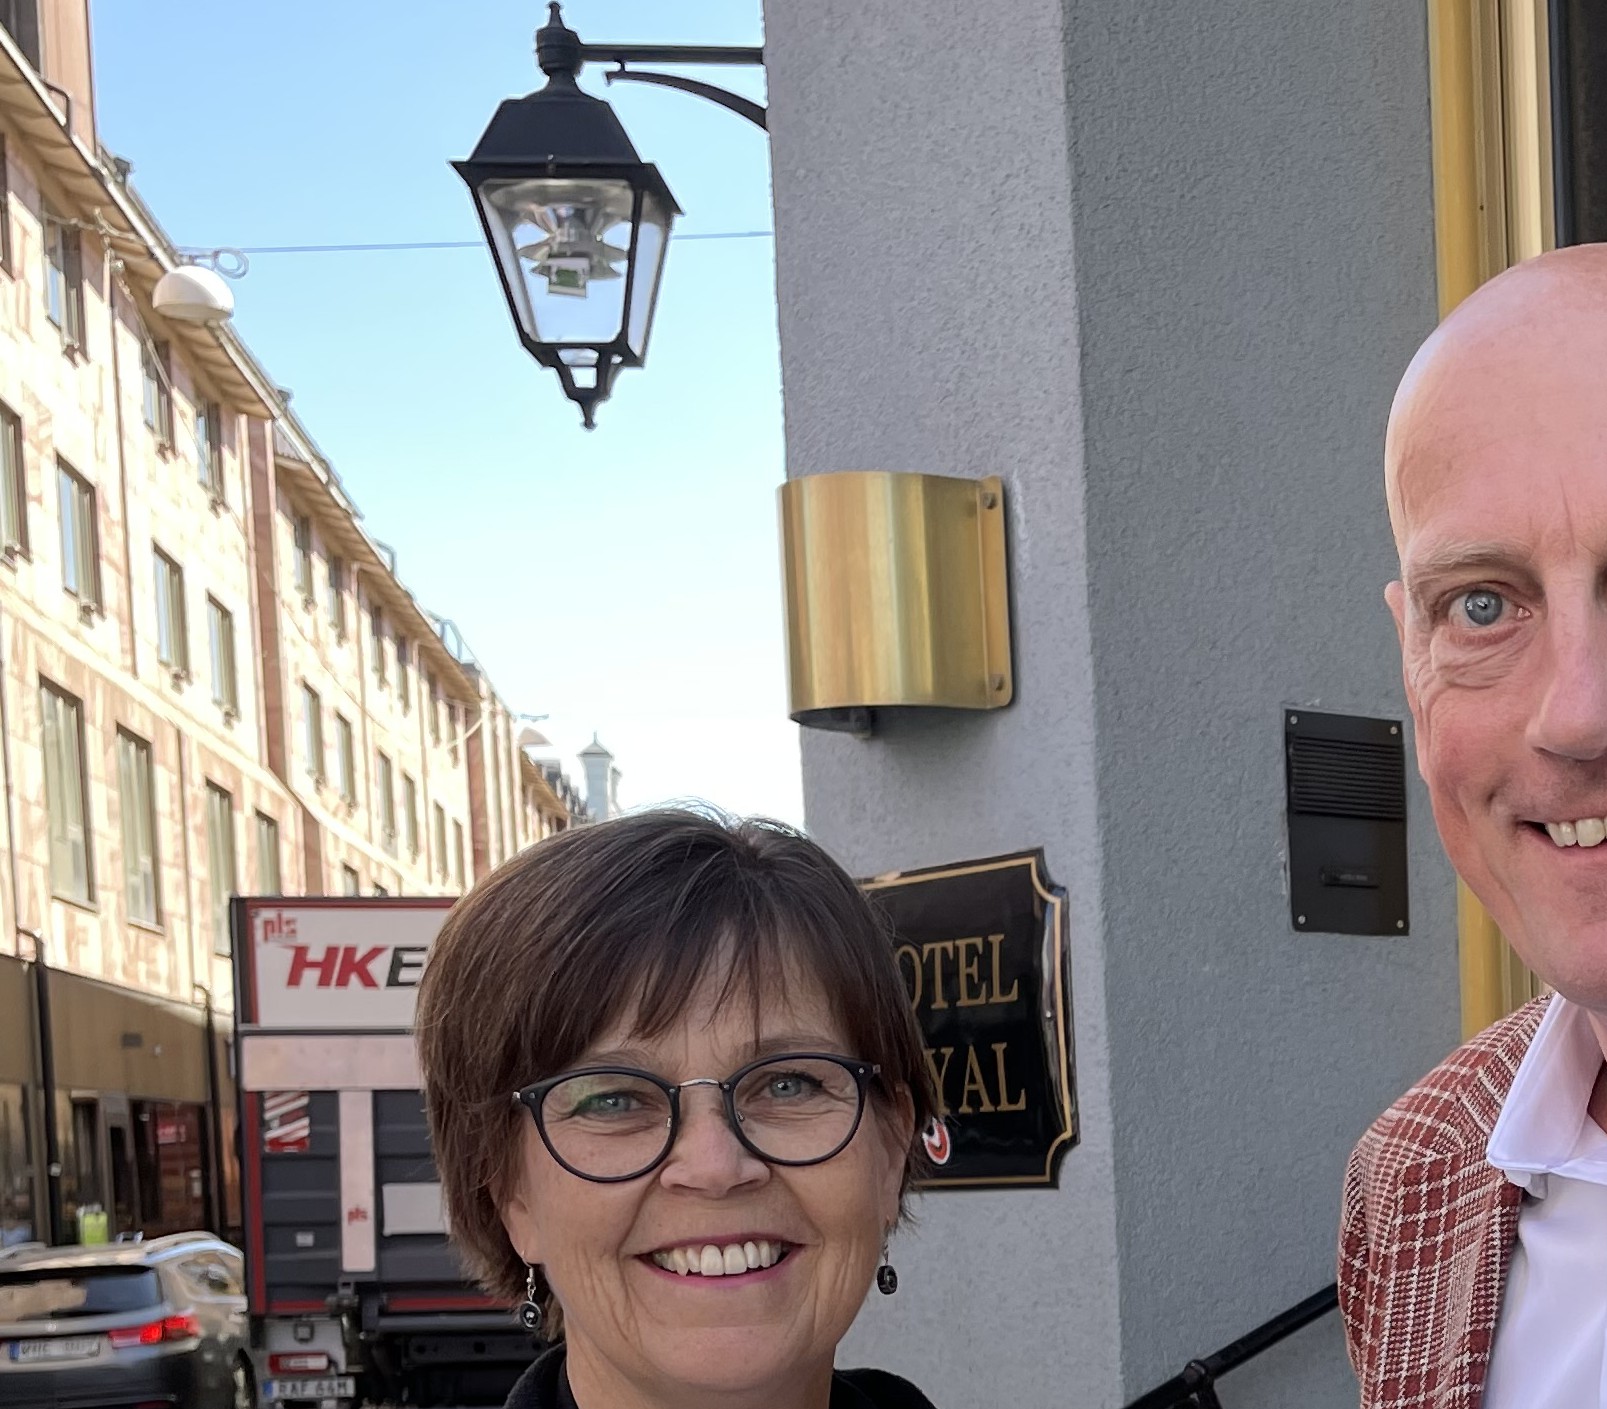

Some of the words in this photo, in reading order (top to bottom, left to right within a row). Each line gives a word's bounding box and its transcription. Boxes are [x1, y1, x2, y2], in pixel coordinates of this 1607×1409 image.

[286, 945, 428, 988] HKE
[895, 933, 1019, 1011] OTEL
[924, 1042, 1026, 1117] YAL
